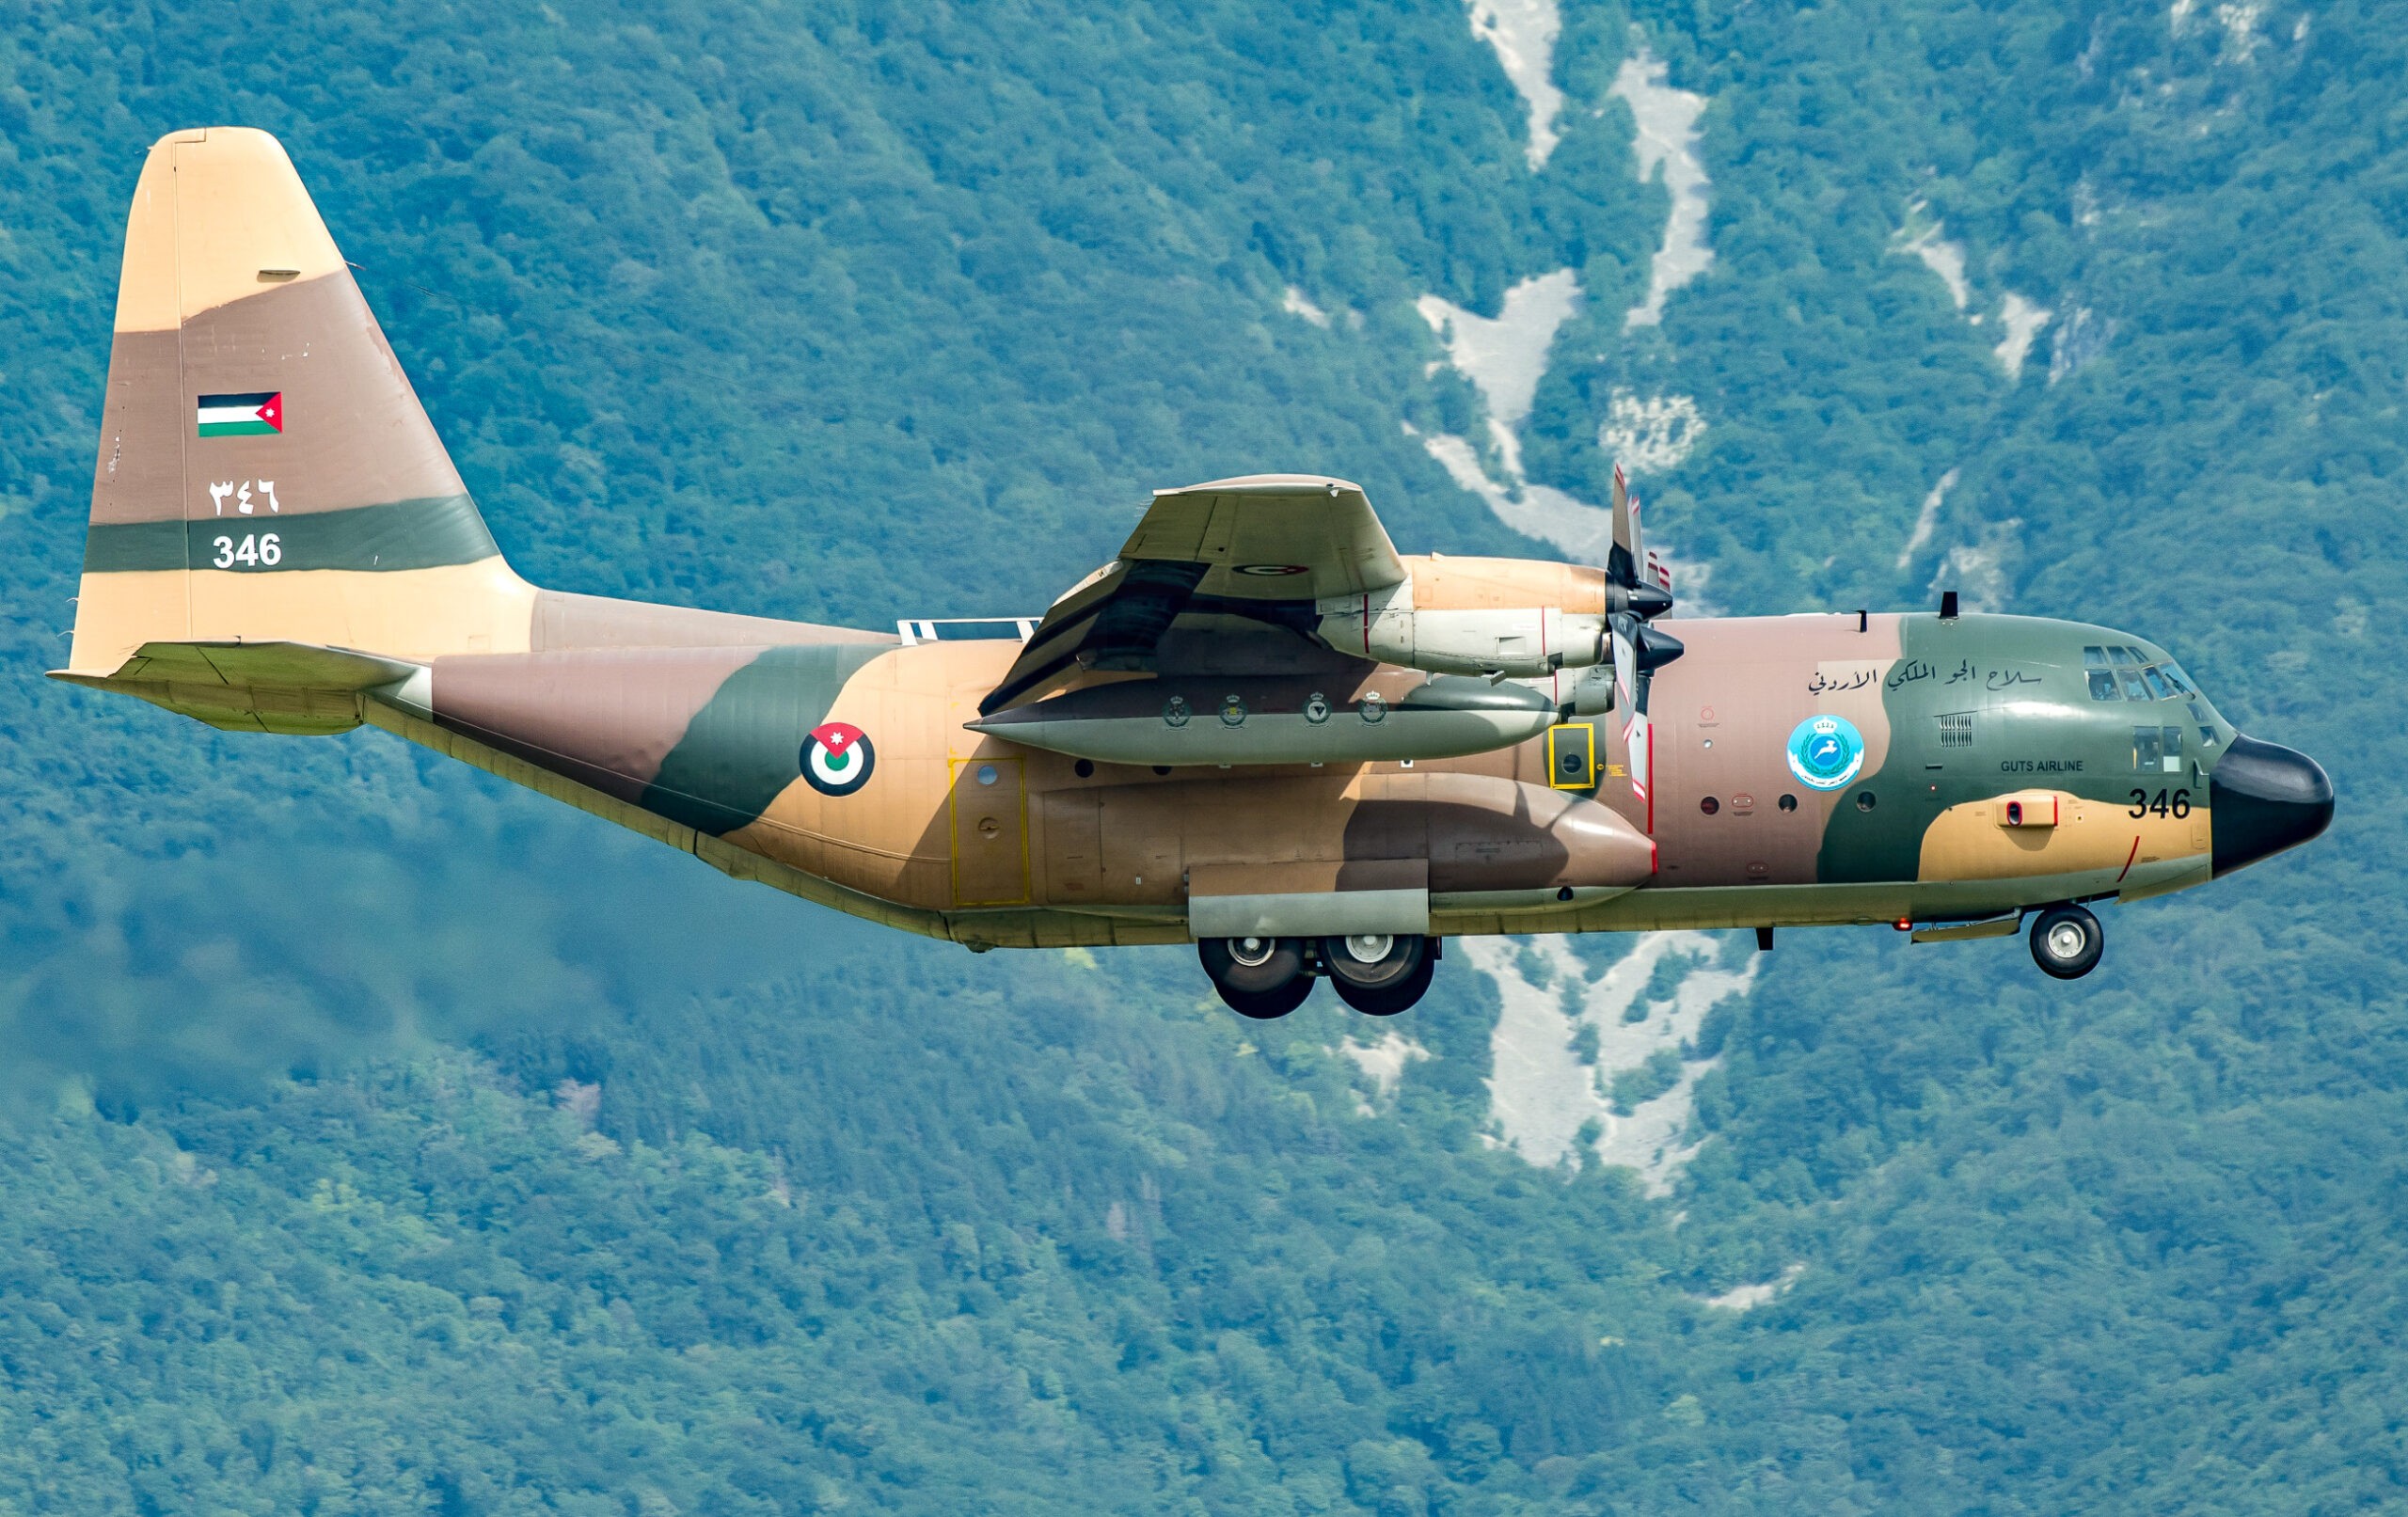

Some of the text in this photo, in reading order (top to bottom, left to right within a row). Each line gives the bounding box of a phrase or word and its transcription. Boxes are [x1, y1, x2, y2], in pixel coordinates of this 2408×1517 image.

[209, 479, 279, 516] ٣٤٦
[213, 532, 281, 569] 346
[1808, 658, 2043, 696] سلاح الجو الملكي الأردني
[2001, 760, 2083, 772] GUTS AIRLINE
[2128, 788, 2191, 819] 346
